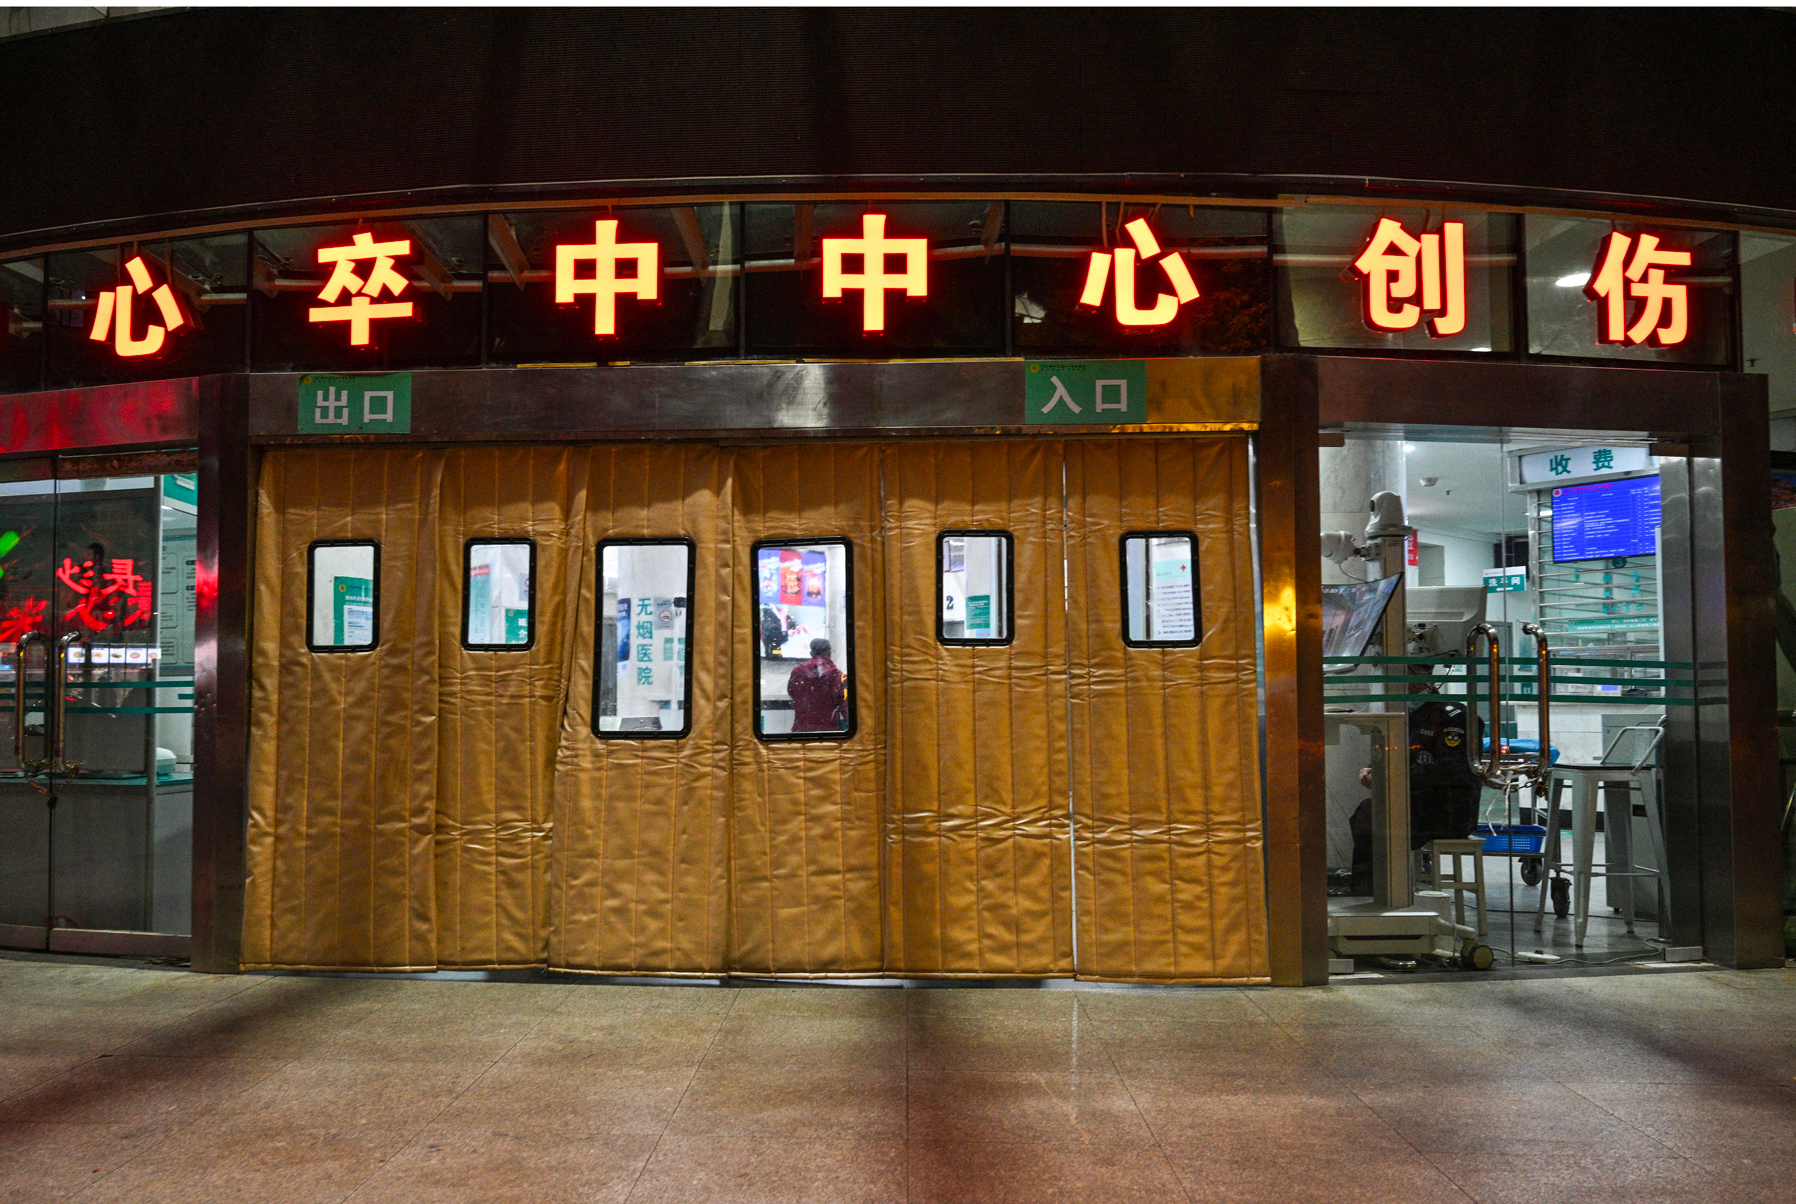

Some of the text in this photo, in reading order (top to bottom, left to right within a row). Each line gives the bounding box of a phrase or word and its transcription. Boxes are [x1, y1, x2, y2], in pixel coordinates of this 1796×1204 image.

[315, 386, 394, 425] 出口
[1041, 375, 1128, 415] 入口
[1549, 448, 1614, 476] 收费
[635, 597, 654, 686] 无烟医院
